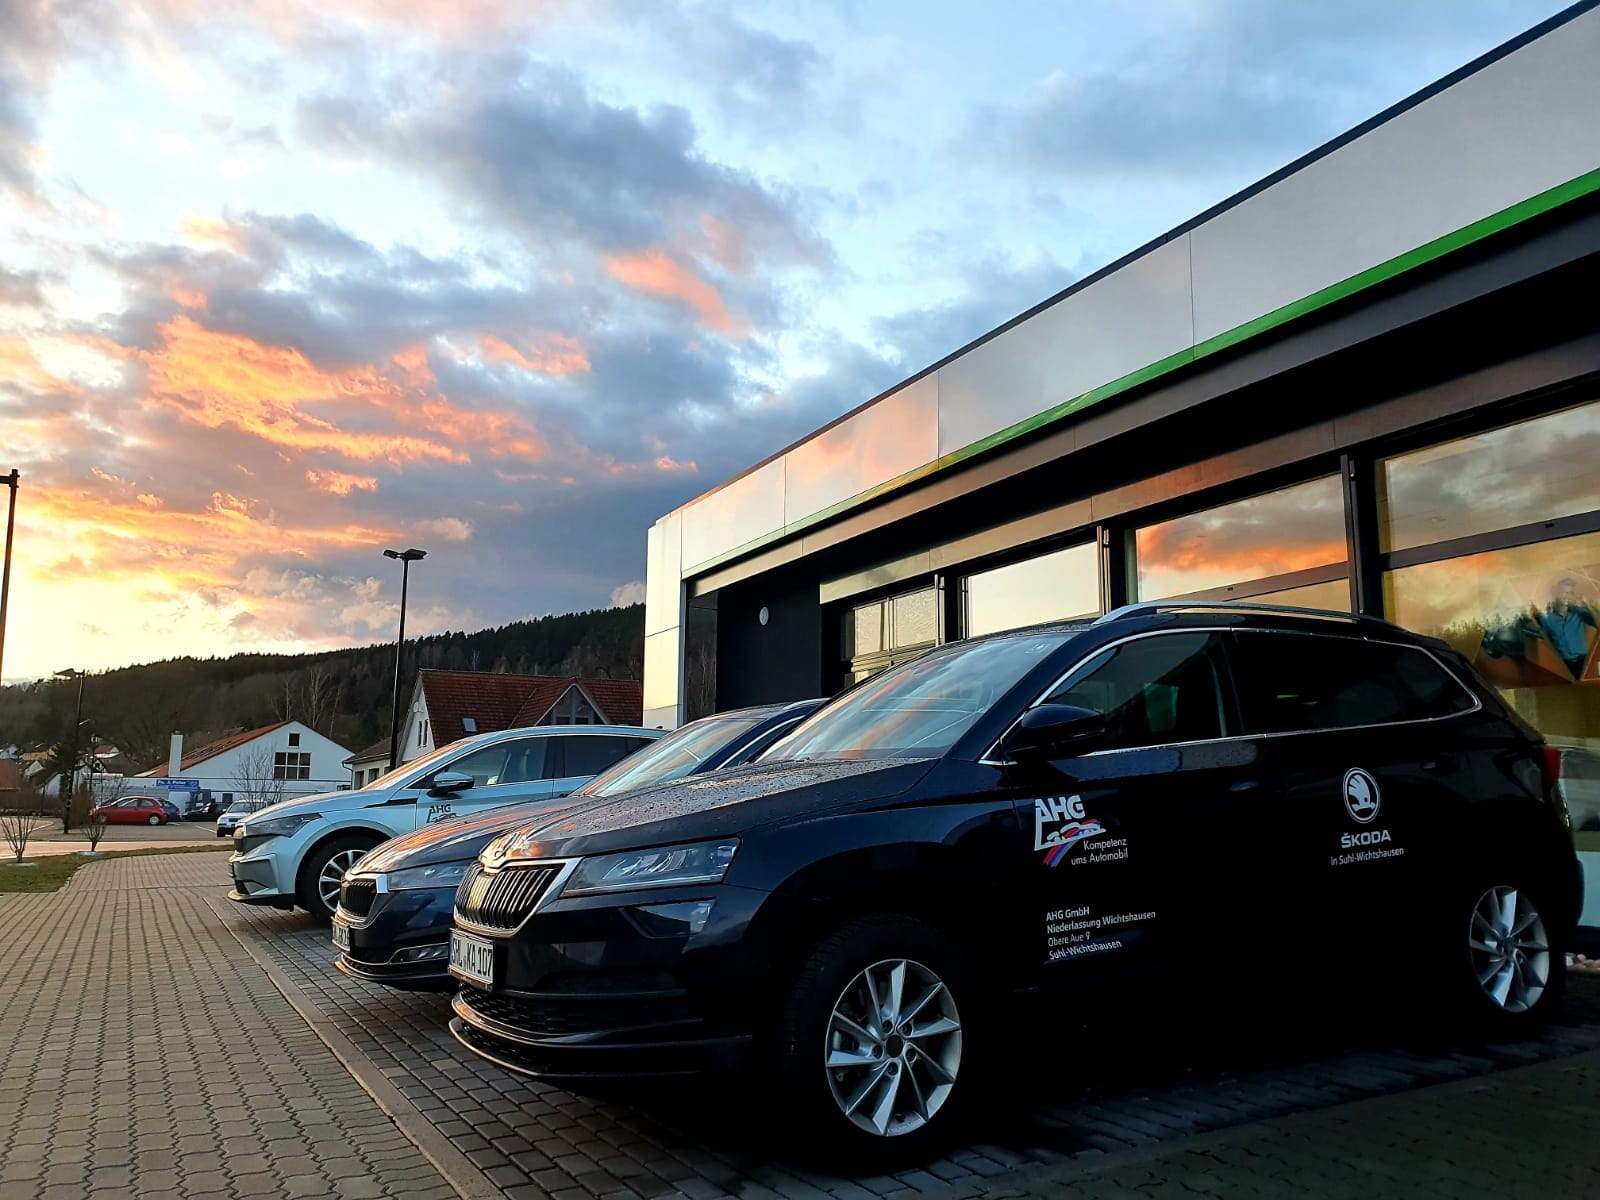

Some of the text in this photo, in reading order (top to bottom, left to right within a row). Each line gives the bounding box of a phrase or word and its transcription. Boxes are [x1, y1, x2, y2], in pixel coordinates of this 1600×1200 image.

[430, 804, 452, 814] AHG
[1034, 795, 1086, 824] AHG
[1083, 838, 1128, 852] Kompetenz
[1341, 830, 1391, 849] ŠKODA
[1071, 848, 1129, 866] ums Automobil
[1330, 848, 1404, 866] in Suhl-Wichtshausen
[1046, 906, 1090, 922] AHG GmbH
[1047, 911, 1156, 934] Niederlassung Wichtshausen
[1048, 931, 1091, 948] Obere Aue 9
[1049, 940, 1121, 960] Suhl-Wichtshausen
[466, 942, 476, 973] KA
[477, 946, 493, 977] 107
